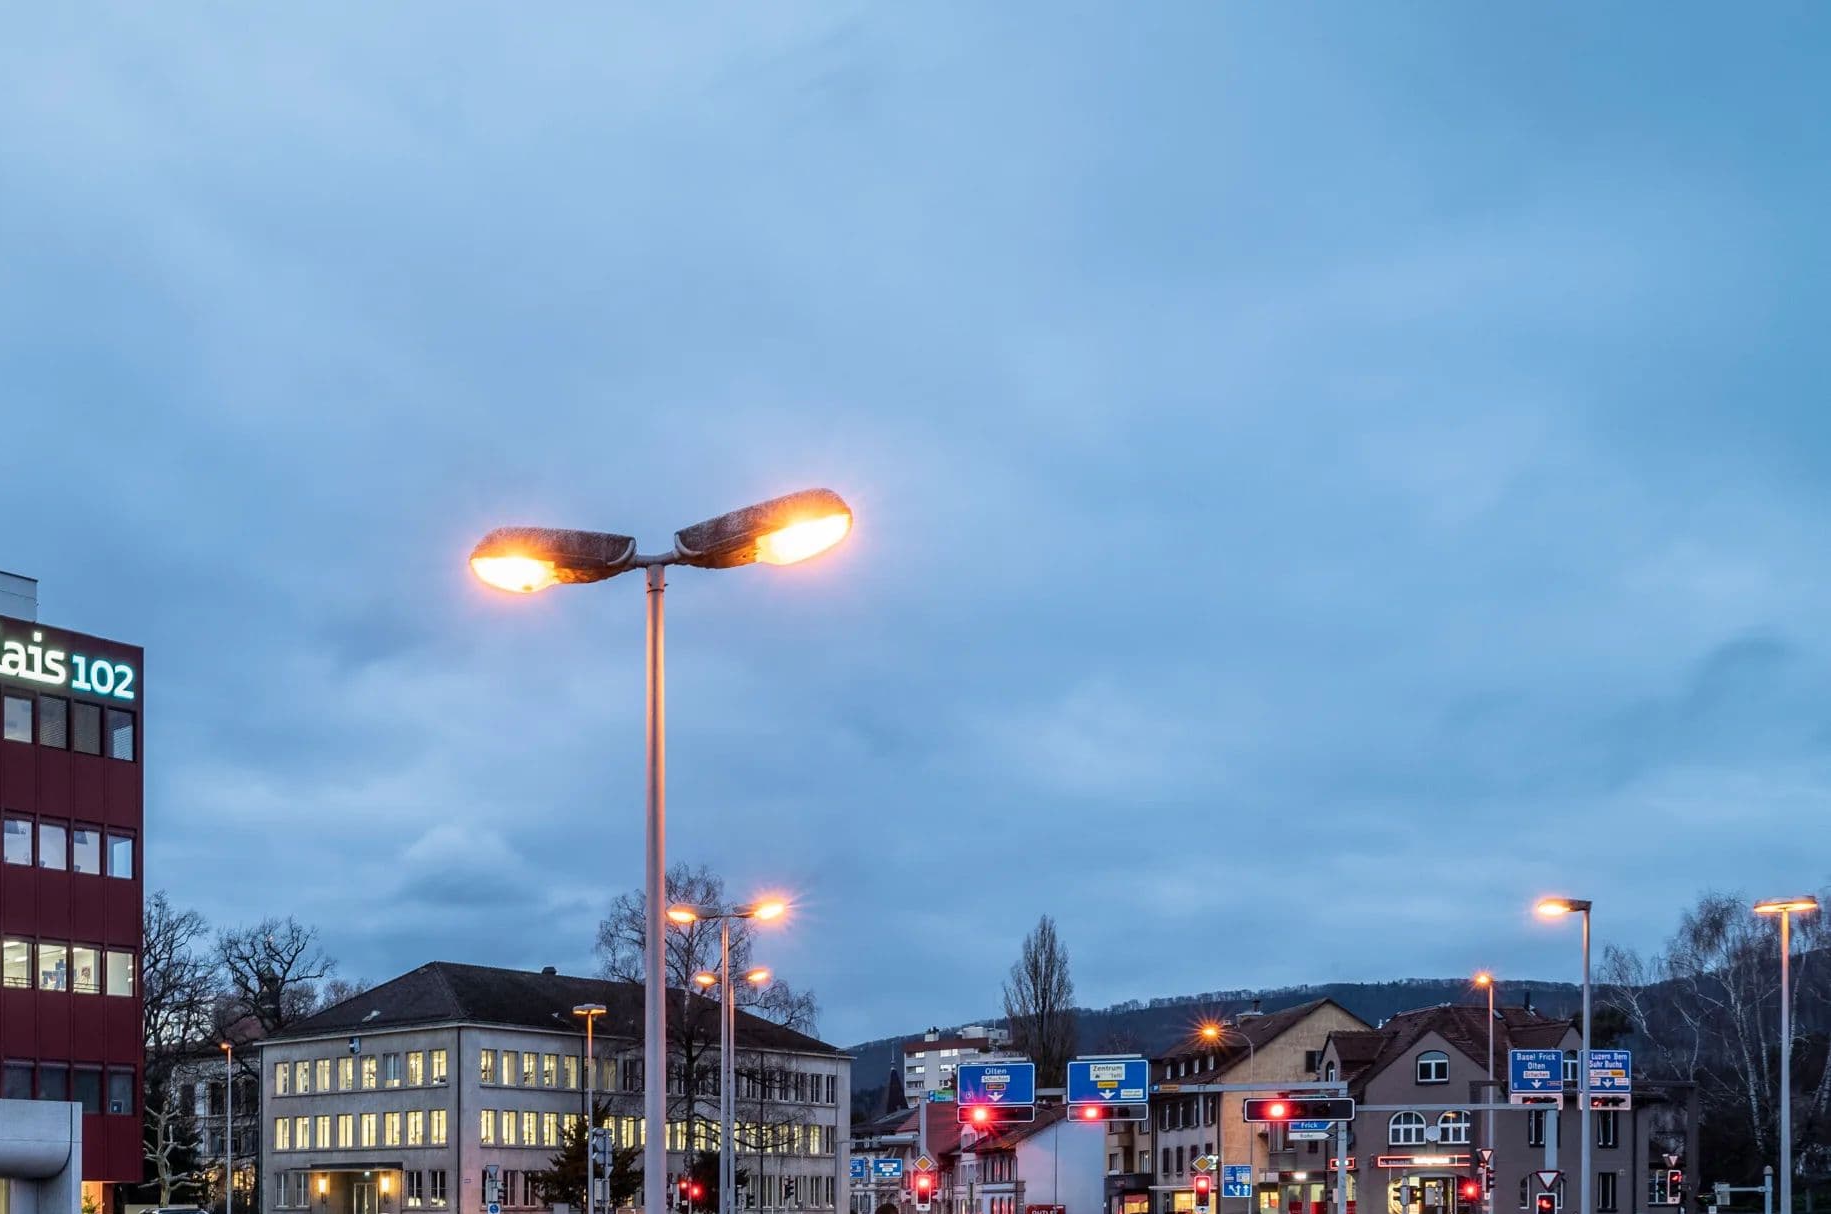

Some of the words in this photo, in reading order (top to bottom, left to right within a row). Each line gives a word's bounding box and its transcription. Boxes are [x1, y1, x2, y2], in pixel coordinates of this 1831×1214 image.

[71, 654, 135, 700] 102
[1516, 1052, 1535, 1061] Basel
[1539, 1052, 1556, 1061] Frick
[1527, 1062, 1546, 1070] Olten
[984, 1067, 1007, 1075] Olten
